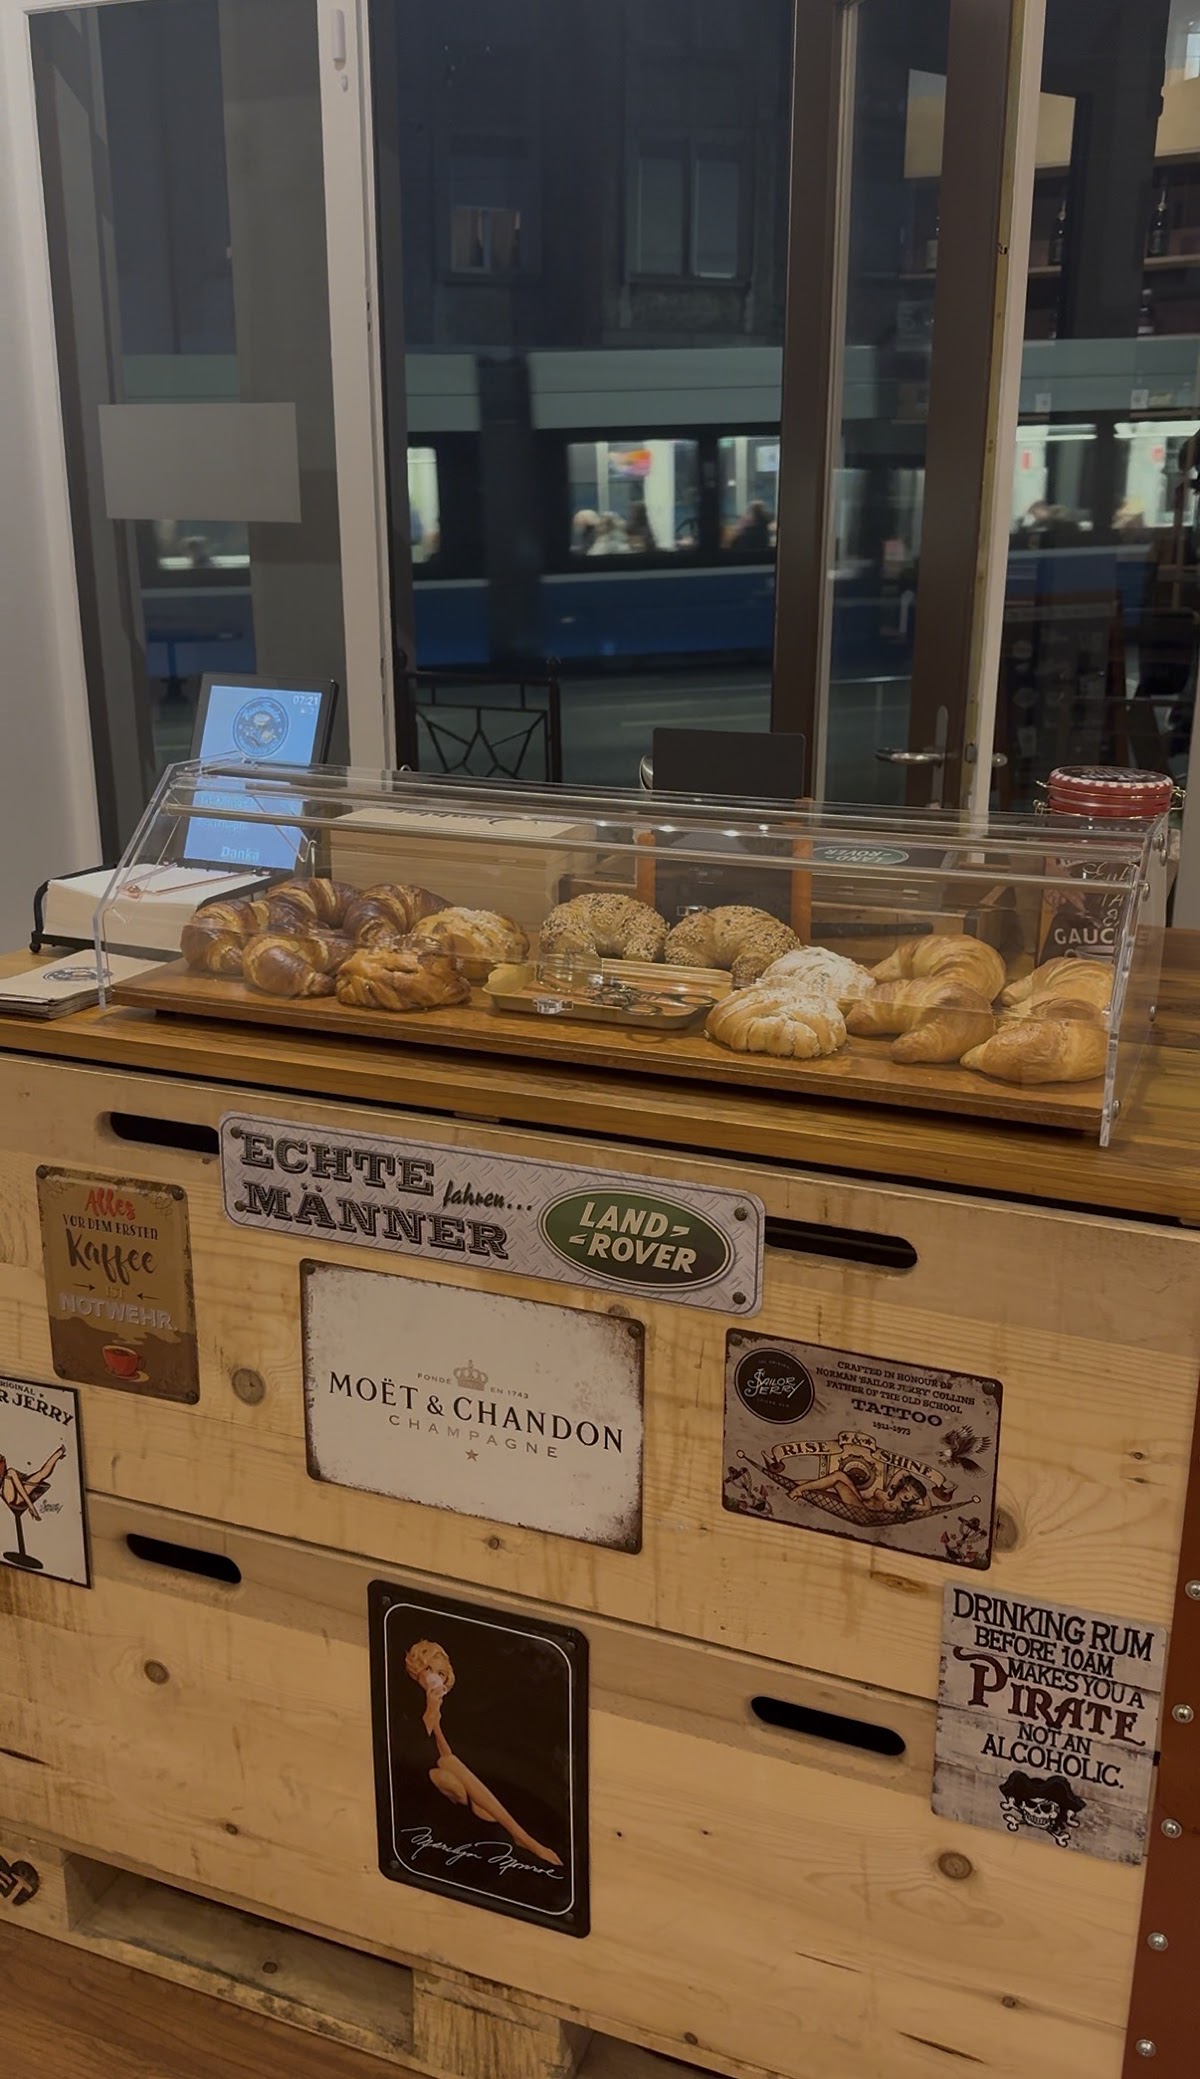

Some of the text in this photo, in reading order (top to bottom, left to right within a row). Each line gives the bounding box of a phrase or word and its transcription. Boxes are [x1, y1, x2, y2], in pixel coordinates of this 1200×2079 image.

[1054, 927, 1116, 944] GAUC
[240, 1128, 434, 1196] ECHTE
[85, 1188, 135, 1220] Alles
[442, 1179, 532, 1211] fahren...
[63, 1214, 158, 1240] VOR DEM ERSTEN
[243, 1181, 509, 1259] MÄNNER
[579, 1201, 668, 1238] LAND
[66, 1228, 157, 1285] Kaffee
[587, 1233, 697, 1274] ROVER
[0, 1381, 35, 1396] RIGINAL
[816, 1367, 858, 1382] NORMAN
[932, 1390, 975, 1406] COLLINS
[838, 1361, 882, 1376] CRAFTED
[884, 1370, 895, 1379] IN
[897, 1373, 938, 1388] HONOUR
[12, 1393, 73, 1426] JERRY
[329, 1371, 623, 1453] MOËT & CHANDON
[507, 1390, 529, 1399] 1743
[827, 1380, 962, 1414] FATHER OF THE OLD SCHOOL
[851, 1399, 942, 1427] TATTOO
[389, 1414, 558, 1458] CHAMPAGNE
[781, 1434, 933, 1478] RISE & SHINE
[953, 1589, 1154, 1661] DRINKING RUM
[974, 1625, 1115, 1678] BEFORE 10AM
[953, 1646, 1146, 1746] PIRATE
[1007, 1657, 1144, 1709] MAKES YOU A
[1017, 1721, 1091, 1755] NOT AN
[981, 1733, 1124, 1788] ALCOHOLIC.
